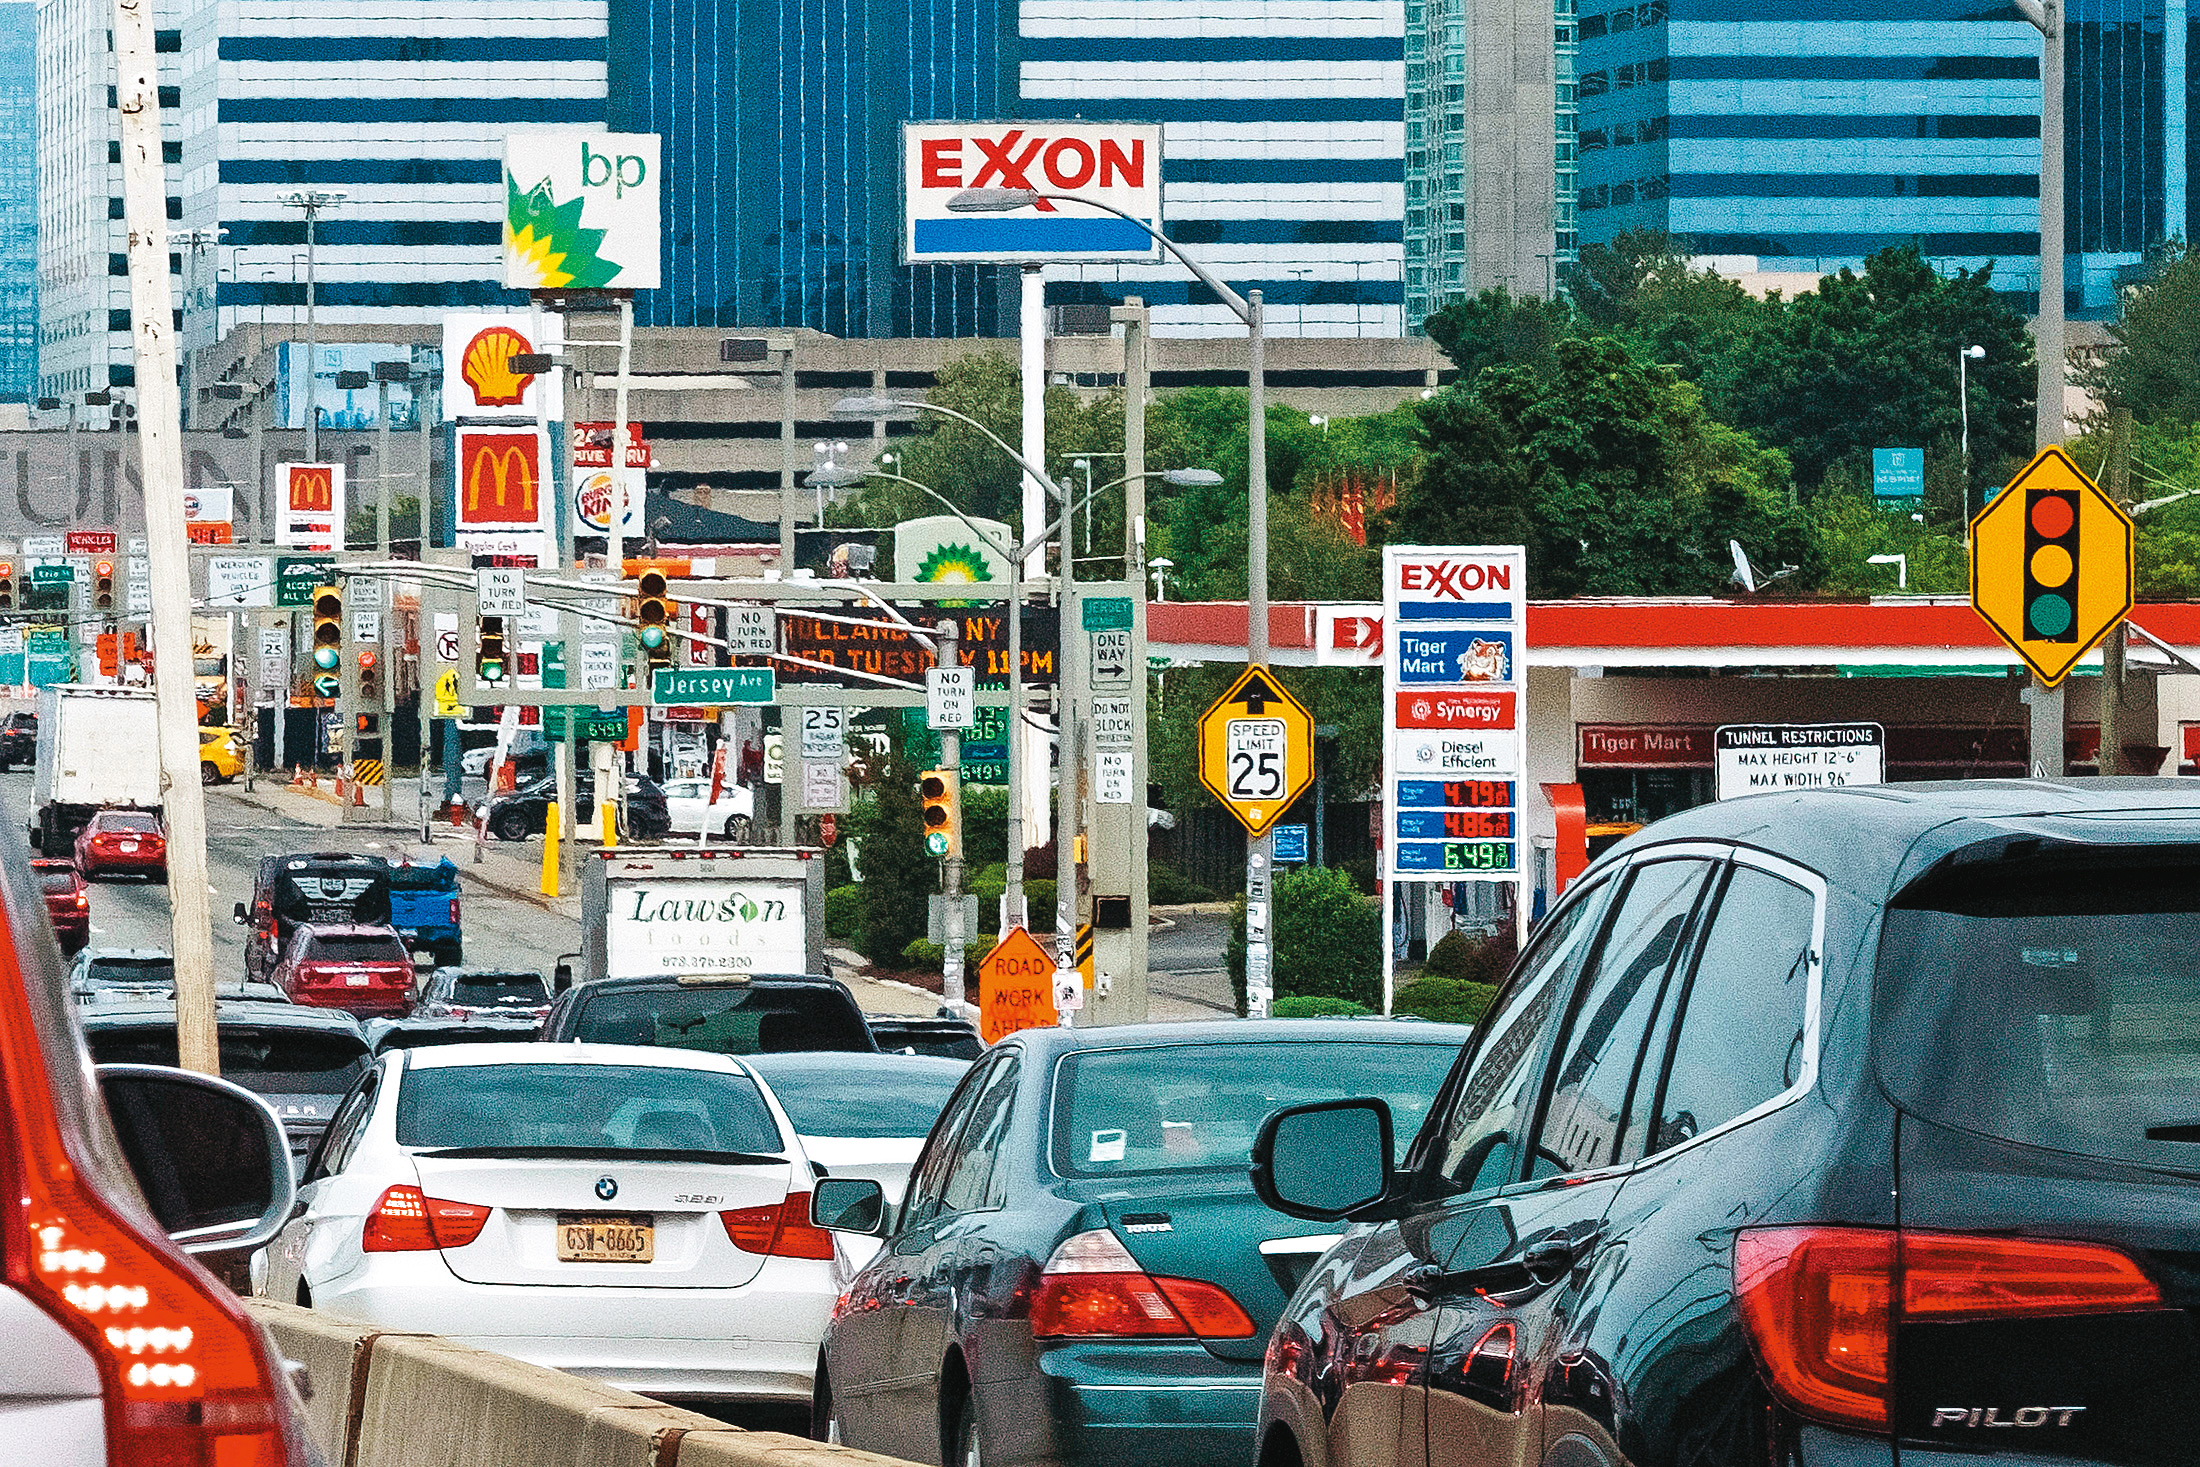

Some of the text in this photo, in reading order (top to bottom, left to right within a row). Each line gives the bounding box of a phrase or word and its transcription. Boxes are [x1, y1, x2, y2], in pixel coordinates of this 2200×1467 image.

[581, 141, 646, 200] bp
[921, 129, 1145, 212] EXXON
[493, 575, 510, 583] NO
[1401, 560, 1510, 601] EXXON
[488, 588, 516, 598] TURN
[482, 600, 522, 610] ON RED
[740, 612, 761, 624] NO
[737, 626, 767, 637] TURN
[966, 617, 1001, 641] NY
[730, 638, 772, 649] ON RED
[1097, 634, 1125, 647] ONE
[1403, 638, 1447, 656] Tiger
[264, 644, 283, 655] 25
[1097, 648, 1126, 661] WAY
[847, 648, 976, 675] TUESDY
[1403, 658, 1445, 673] Mart
[941, 673, 961, 684] NO
[665, 673, 762, 698] Jersey Ave
[937, 687, 965, 697] TURN
[943, 700, 959, 709] ON
[1095, 703, 1130, 714] DO NOT
[940, 713, 962, 722] RED
[1437, 701, 1501, 722] Synergy
[805, 709, 841, 729] 25
[1096, 719, 1131, 731] BLOCK
[1232, 724, 1281, 737] SPEED
[1725, 729, 1874, 745] TUNNEL RESTRICTIONS
[1237, 738, 1276, 751] LIMIT
[1441, 740, 1484, 754] Diesel
[1588, 733, 1692, 753] Tiger Mart
[1103, 757, 1122, 766] NO
[1442, 755, 1497, 768] Efficient
[1738, 753, 1768, 766] MAX
[1773, 752, 1819, 766] HEIGHT
[1232, 752, 1281, 796] 25
[1750, 773, 1778, 786] MAX
[1783, 773, 1822, 786] WIDTH
[627, 890, 787, 924] Lawson
[995, 958, 1046, 976] ROAD
[995, 989, 1046, 1007] WORK
[1931, 1405, 2088, 1428] PILOT
